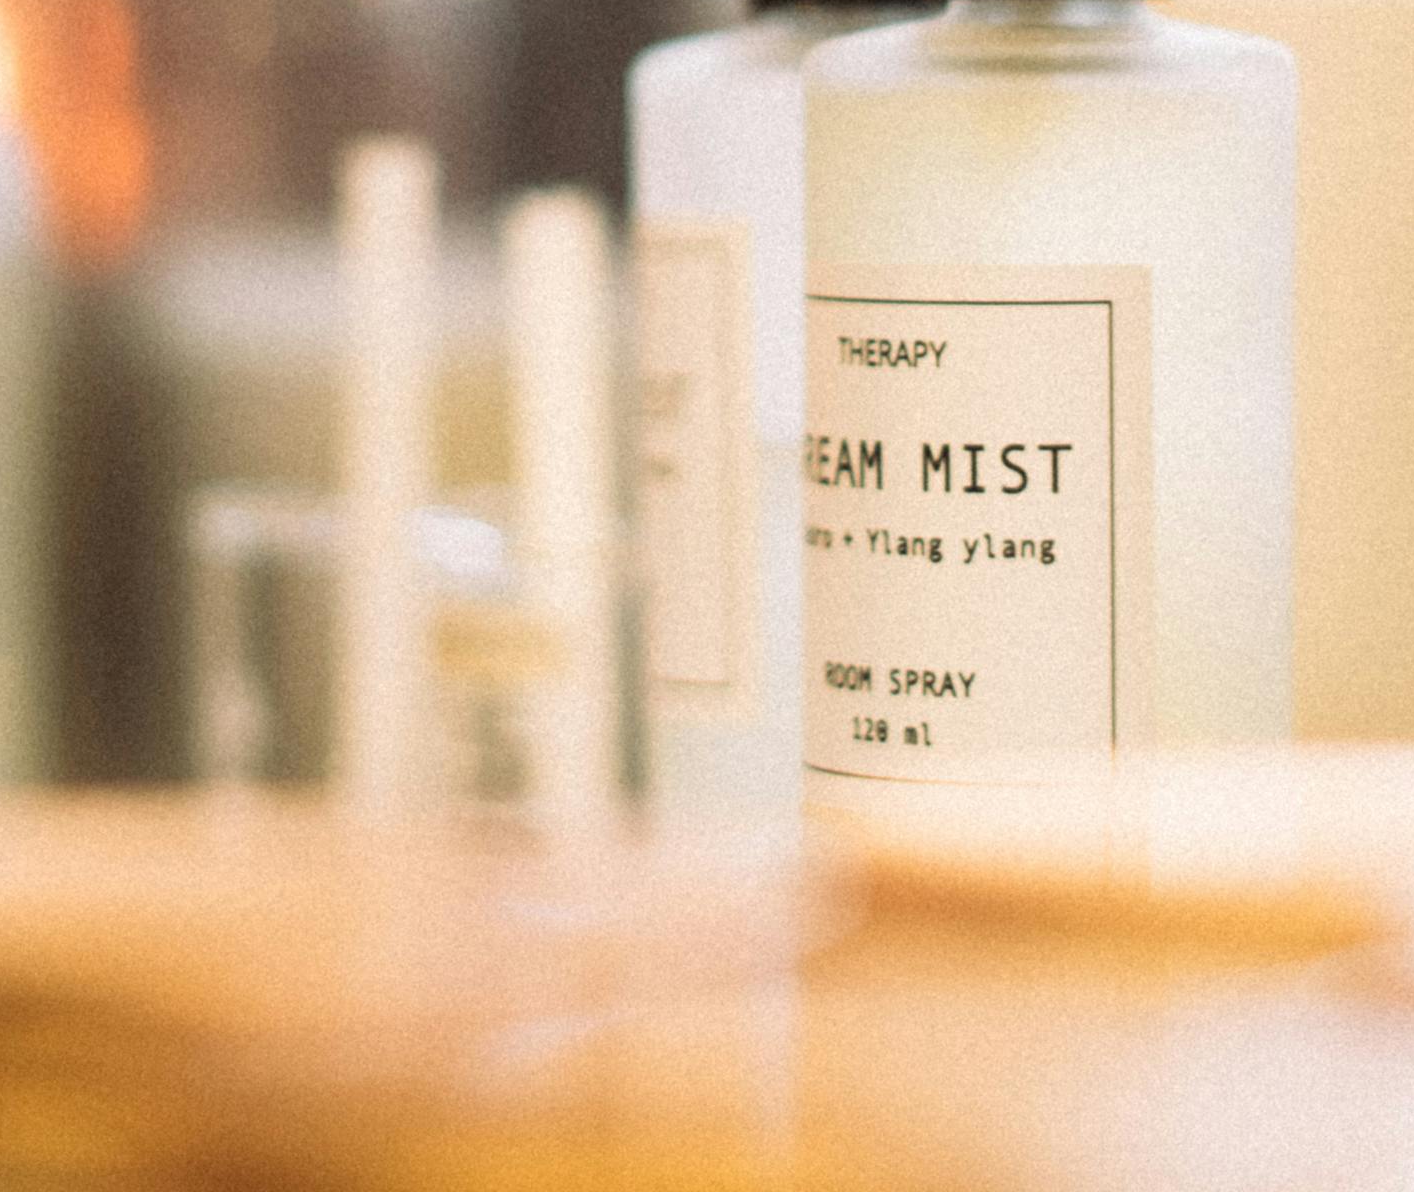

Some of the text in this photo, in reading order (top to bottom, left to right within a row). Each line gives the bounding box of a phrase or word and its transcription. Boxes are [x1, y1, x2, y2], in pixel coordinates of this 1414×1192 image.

[838, 337, 947, 368] THERAPY
[922, 443, 1073, 495] MIST
[866, 528, 942, 563] Ylang
[963, 534, 1056, 565] ylang
[825, 661, 976, 698] ROOM SPRAY
[904, 722, 932, 747] ml
